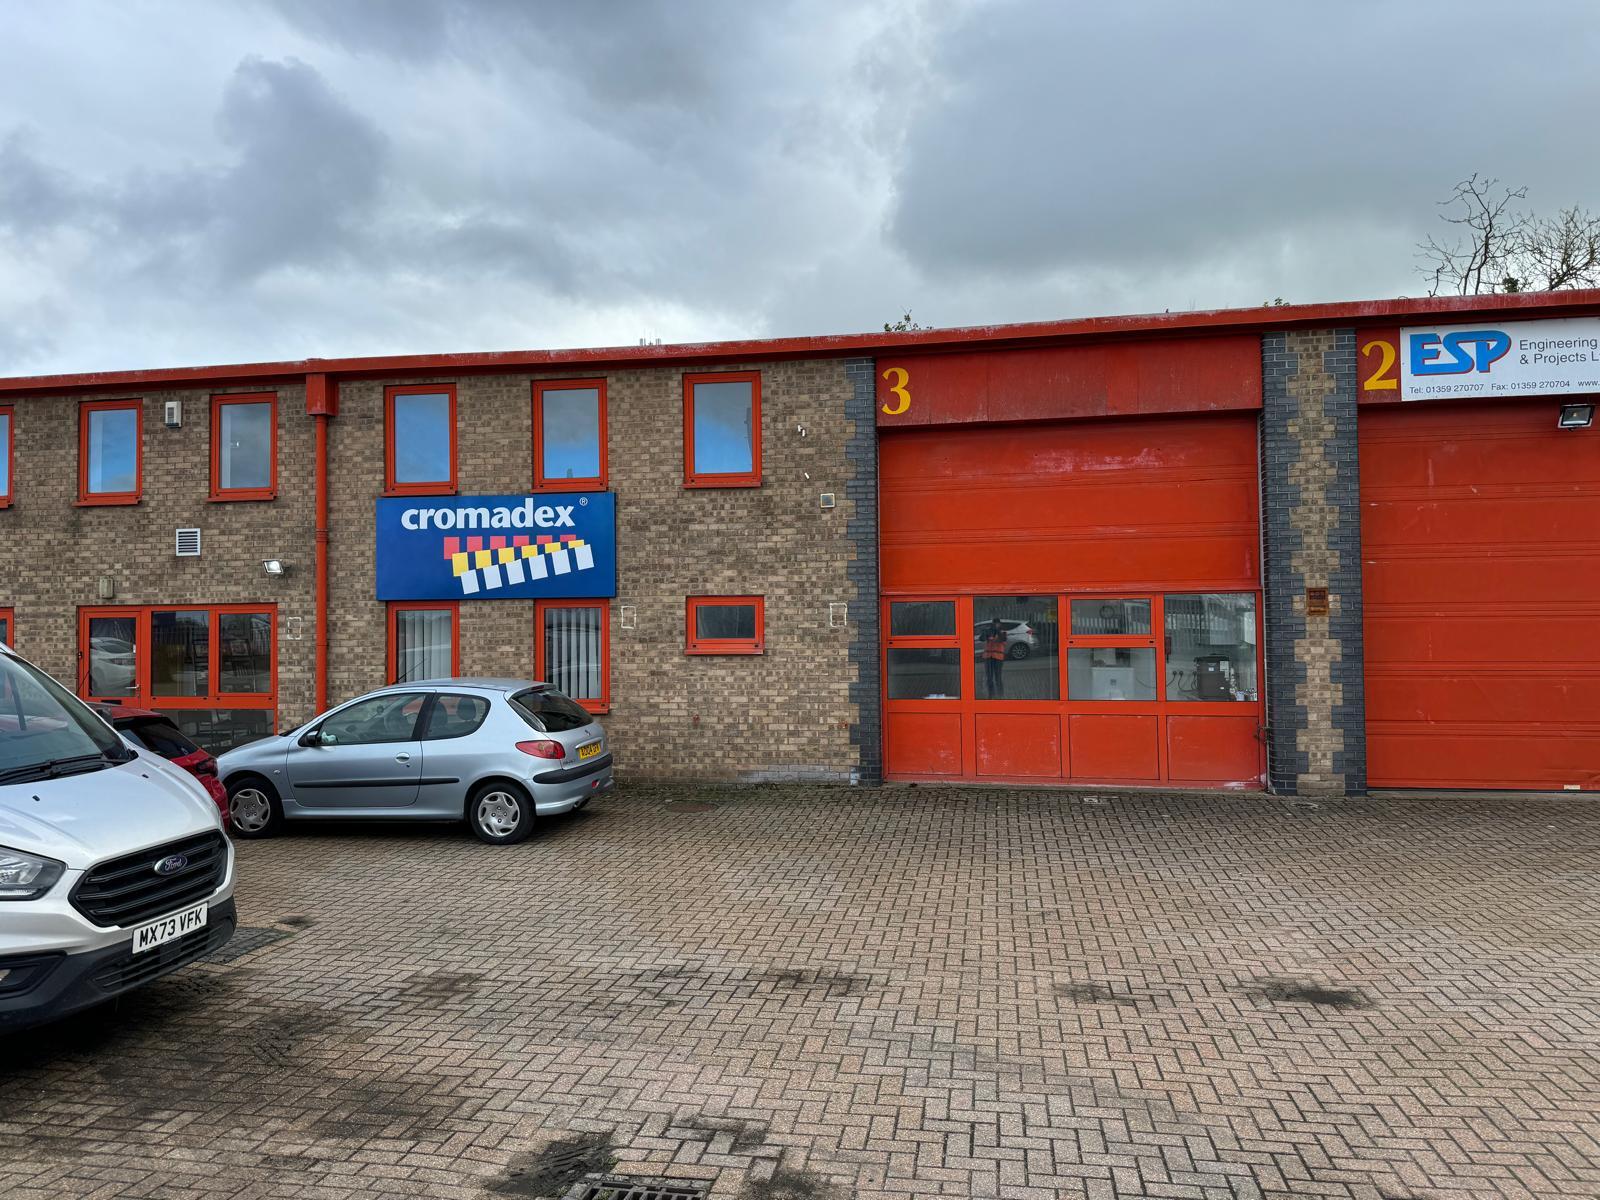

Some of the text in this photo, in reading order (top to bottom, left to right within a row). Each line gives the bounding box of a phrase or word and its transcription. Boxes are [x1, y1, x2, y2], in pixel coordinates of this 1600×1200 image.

[1409, 330, 1512, 376] ESP
[1519, 337, 1598, 352] Engineering
[1519, 351, 1600, 365] & Projects L
[1361, 340, 1398, 391] 2
[881, 367, 911, 415] 3
[1409, 386, 1424, 394] Tel:
[1425, 385, 1451, 393] 01359
[1453, 383, 1484, 392] 270707
[1491, 382, 1509, 391] Fax:
[1510, 381, 1537, 390] 01359
[1539, 380, 1570, 389] 270704
[401, 498, 576, 530] cromadex
[164, 857, 183, 871] Ford
[139, 908, 202, 947] MX73 VFK
